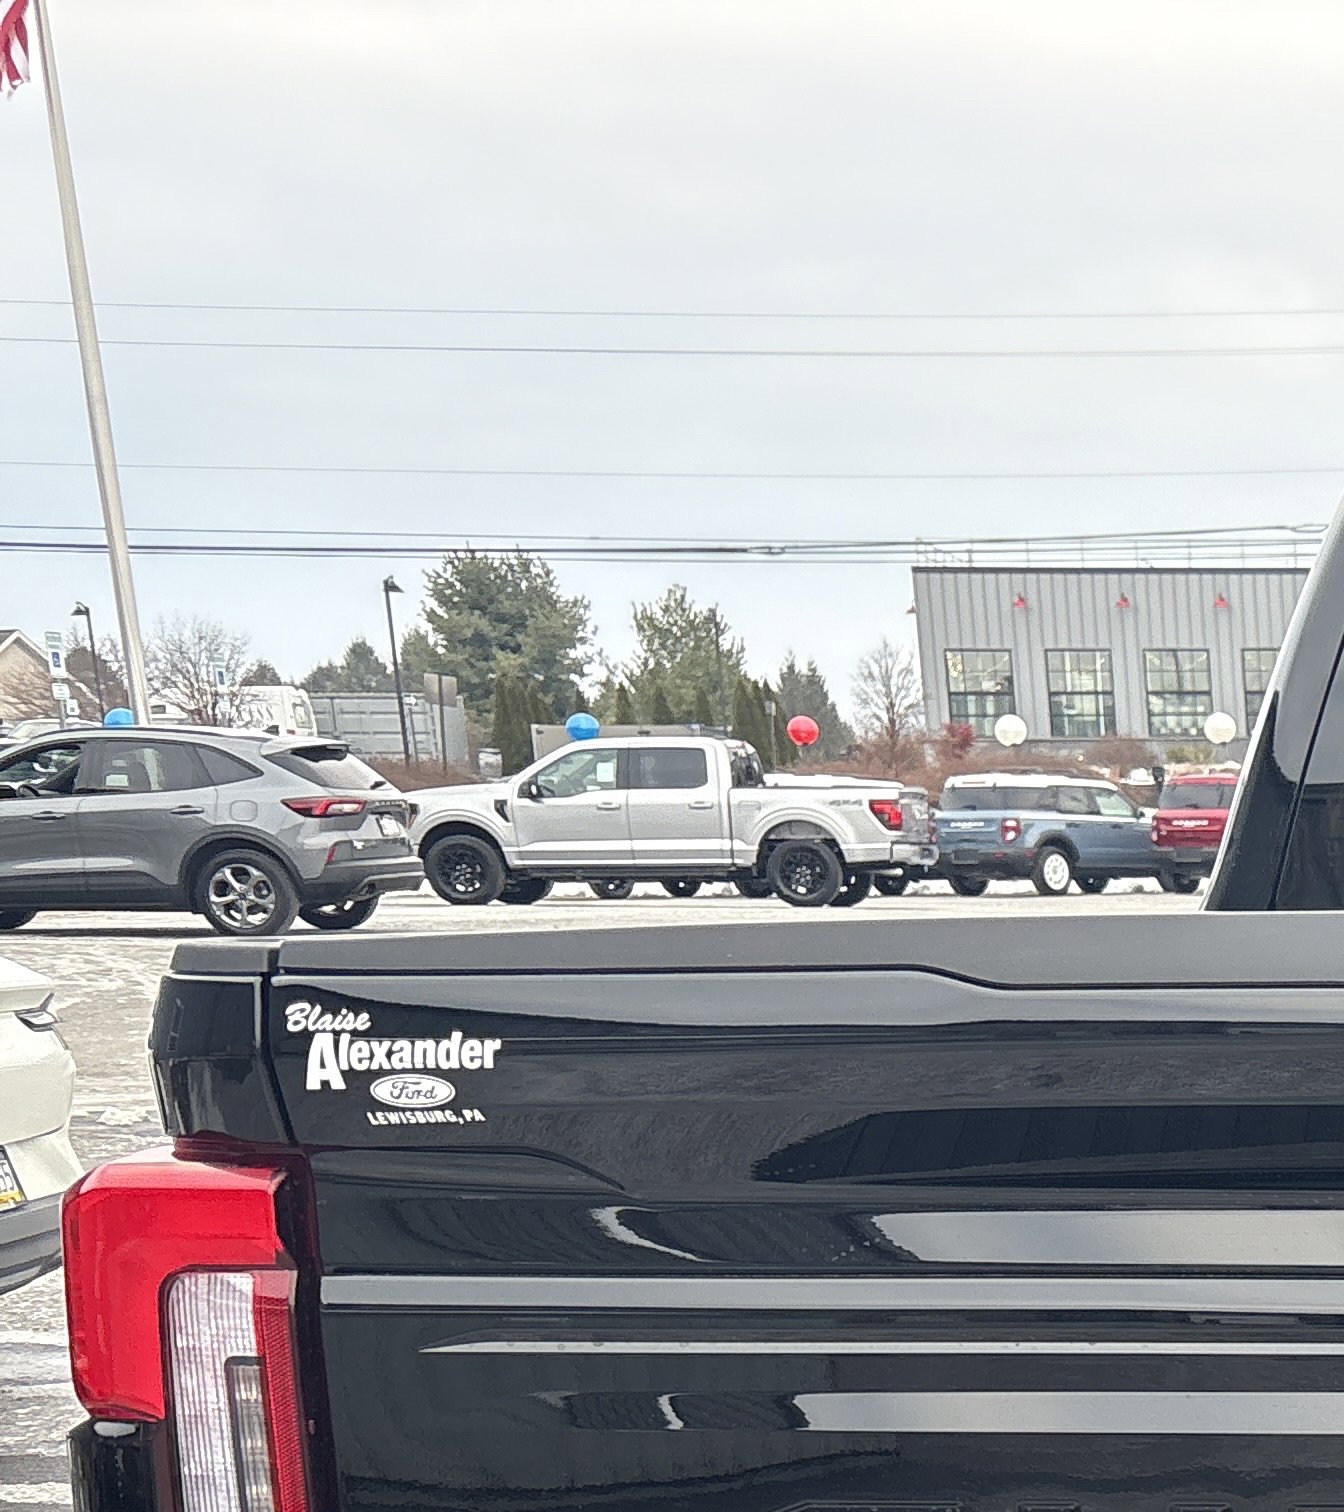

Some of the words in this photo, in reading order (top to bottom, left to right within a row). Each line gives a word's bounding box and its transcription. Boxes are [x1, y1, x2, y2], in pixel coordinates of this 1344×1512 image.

[284, 1001, 372, 1032] Blaise
[305, 1030, 502, 1090] Alexander
[389, 1080, 438, 1100] Ford
